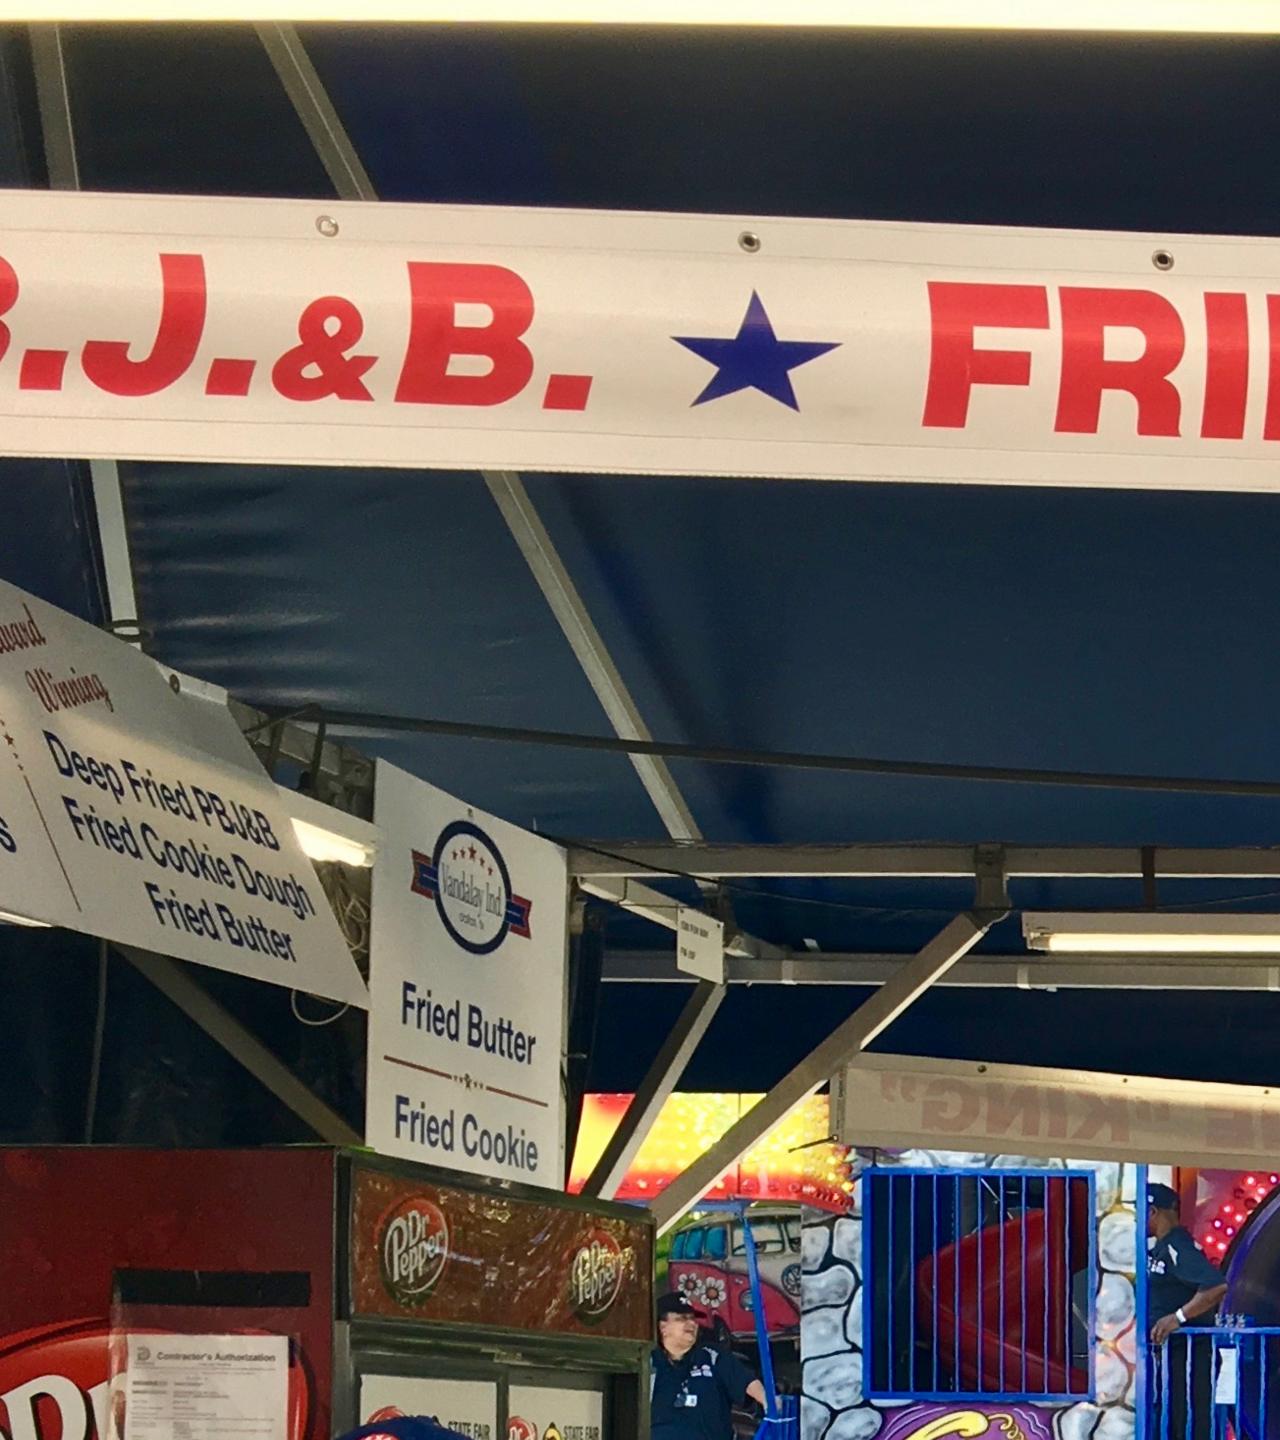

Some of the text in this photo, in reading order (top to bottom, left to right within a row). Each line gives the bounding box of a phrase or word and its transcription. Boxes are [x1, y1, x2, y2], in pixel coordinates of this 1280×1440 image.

[24, 667, 115, 712] Winning
[42, 729, 280, 851] Deep Fried PBJ&B
[61, 795, 143, 860] Fried
[141, 822, 236, 890] Cookie
[232, 853, 317, 920] Dough
[144, 881, 297, 962] Fried Butter
[402, 981, 537, 1066] Fried Butter
[394, 1095, 539, 1173] Fried Cookie
